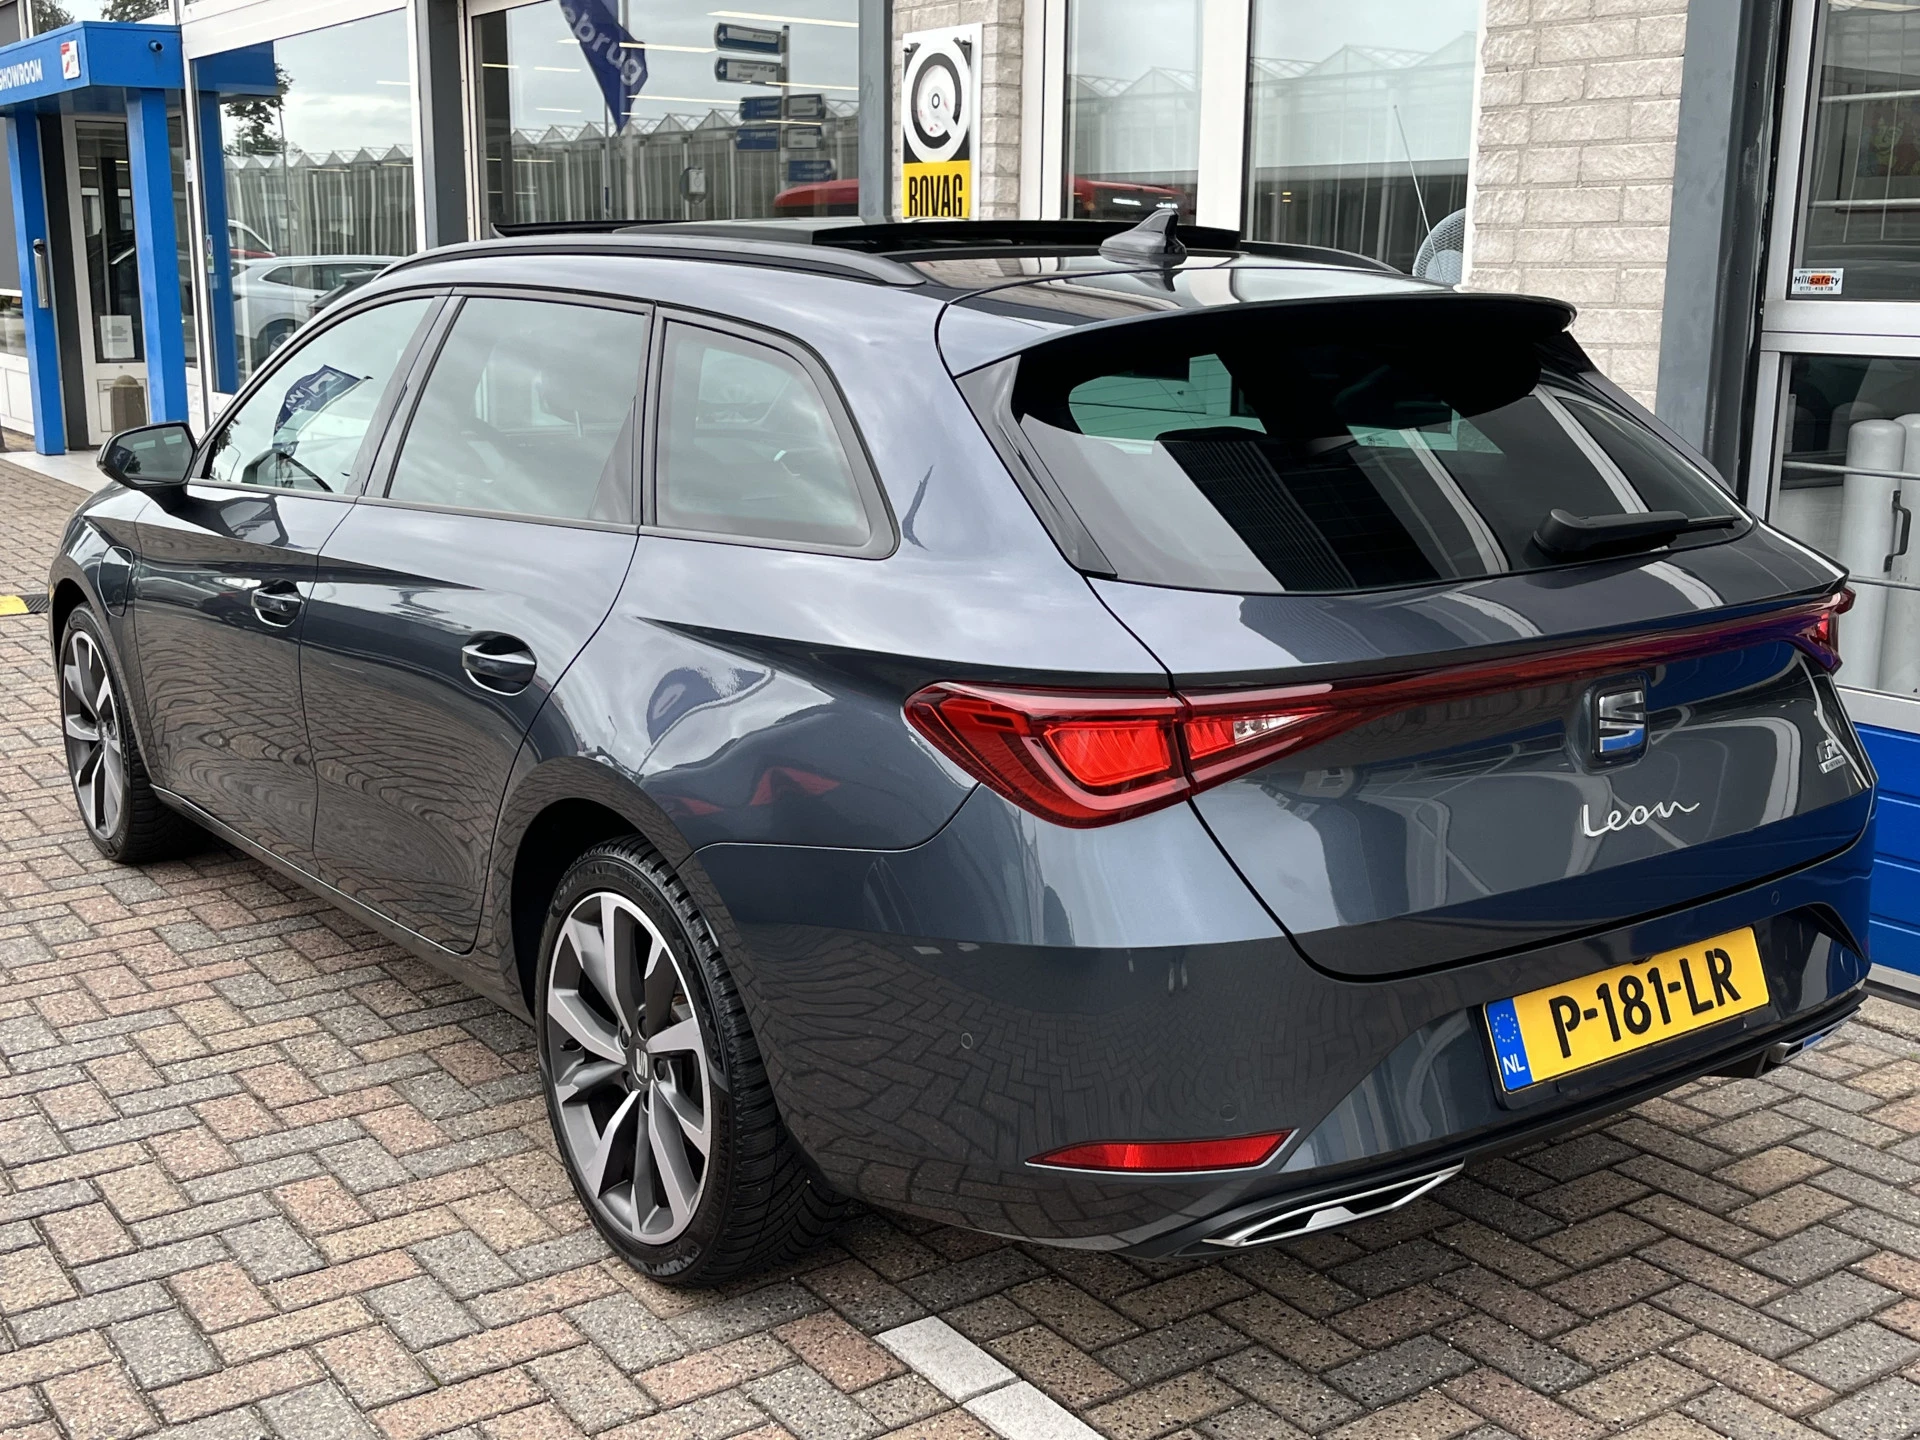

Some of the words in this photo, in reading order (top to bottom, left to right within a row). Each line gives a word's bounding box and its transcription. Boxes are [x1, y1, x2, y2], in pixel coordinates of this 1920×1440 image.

[908, 174, 963, 217] BOVAG
[1793, 275, 1840, 286] Hillsafety
[1581, 801, 1700, 837] Leon
[1548, 947, 1742, 1059] P-181-LR
[1502, 1053, 1526, 1076] NL
